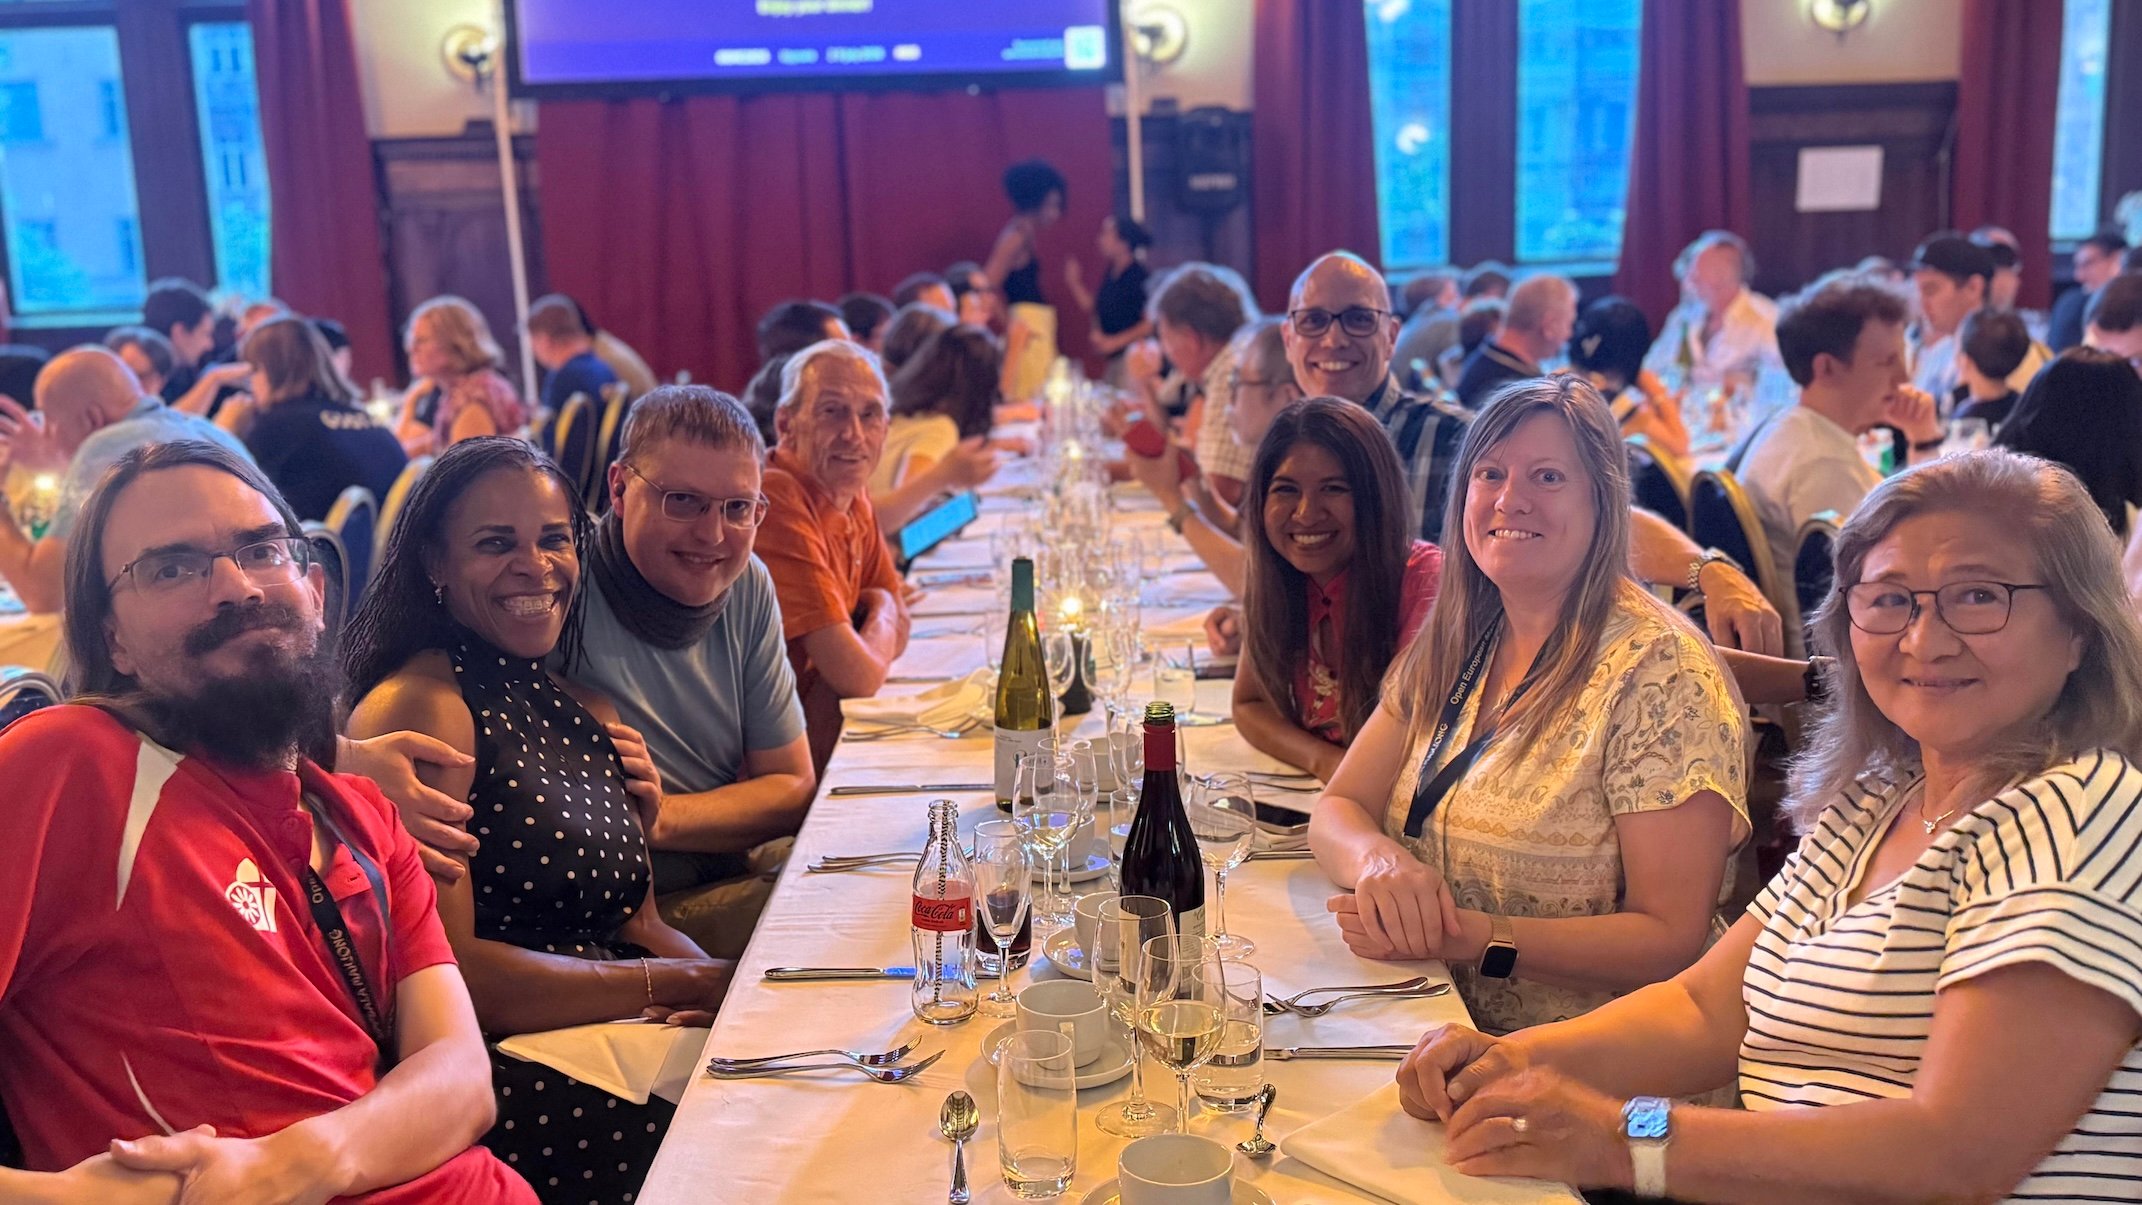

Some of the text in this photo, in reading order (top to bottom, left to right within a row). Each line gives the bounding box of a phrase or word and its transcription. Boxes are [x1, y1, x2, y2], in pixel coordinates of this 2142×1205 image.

[1449, 640, 1487, 705] Open European
[308, 873, 324, 904] Ope
[915, 900, 956, 920] Coca-Cola
[329, 928, 365, 988] MAHJONG
